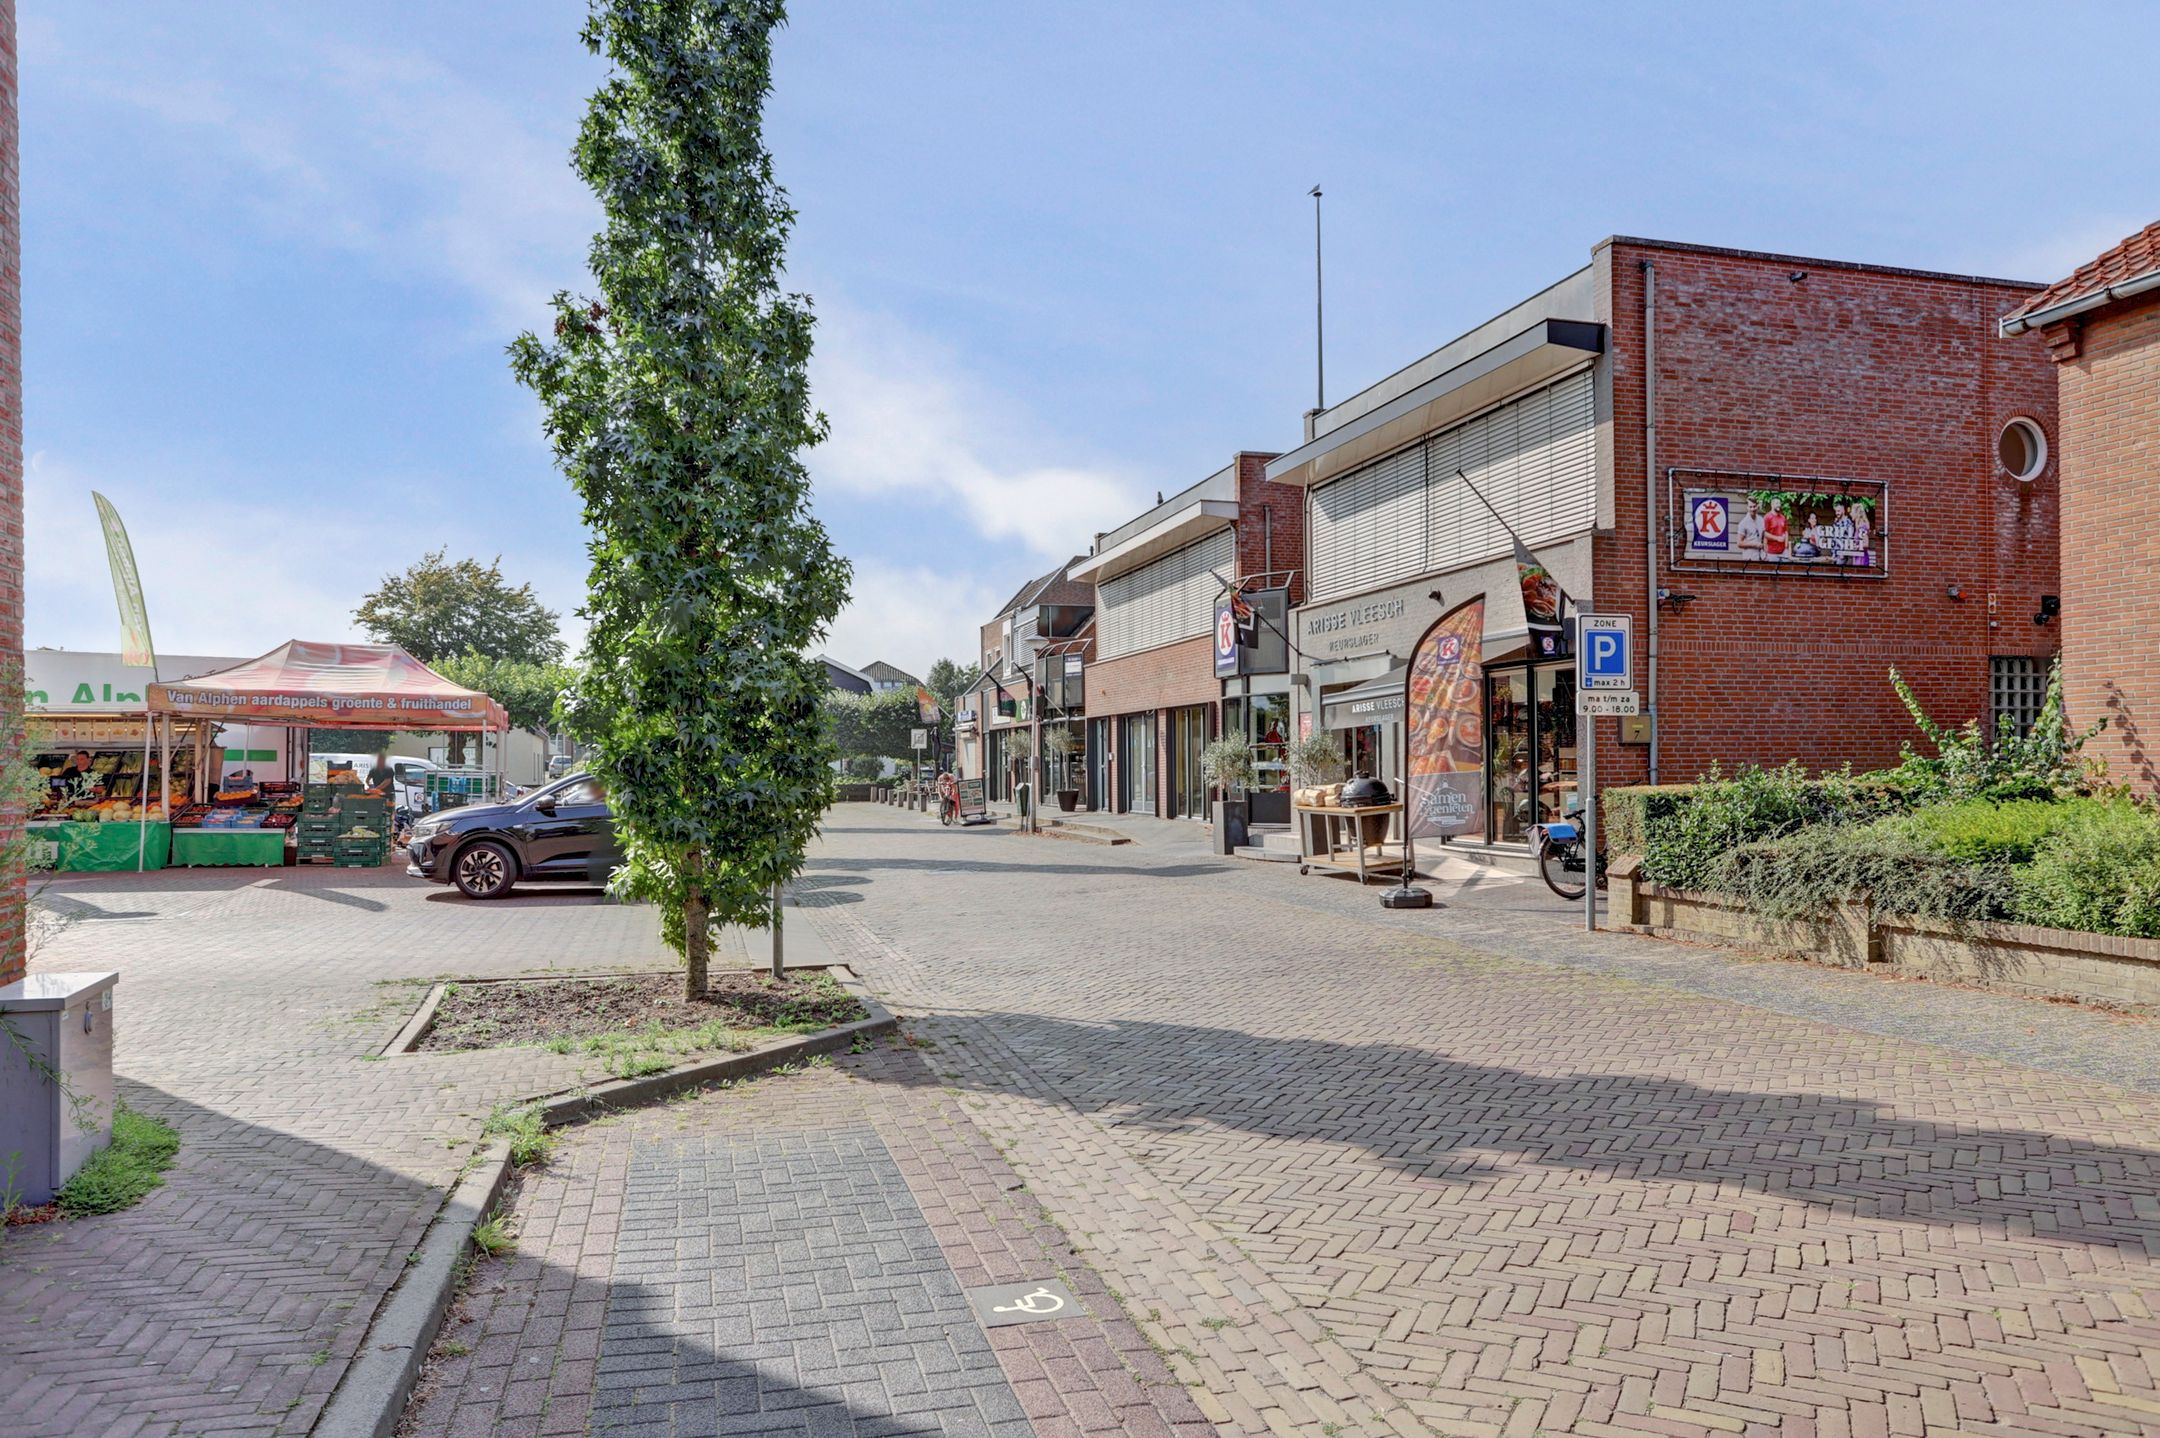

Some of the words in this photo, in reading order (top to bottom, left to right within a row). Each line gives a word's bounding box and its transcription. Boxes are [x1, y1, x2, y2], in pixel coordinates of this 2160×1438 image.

[1700, 511, 1721, 532] K
[1308, 613, 1347, 636] ARISSE
[1350, 600, 1404, 627] VLEESCH
[1220, 622, 1231, 649] K
[1329, 633, 1379, 652] KEURSLAGER
[1595, 636, 1616, 670] P
[167, 689, 193, 704] Van
[198, 692, 247, 706] Alphen
[251, 694, 328, 709] aardappels
[332, 697, 383, 710] groente
[387, 697, 397, 709] &
[400, 697, 472, 710] fruithandel
[1352, 702, 1375, 713] ARISSE
[1583, 705, 1603, 713] 9.00
[1612, 705, 1635, 713] 18.00
[1603, 695, 1617, 703] t/m
